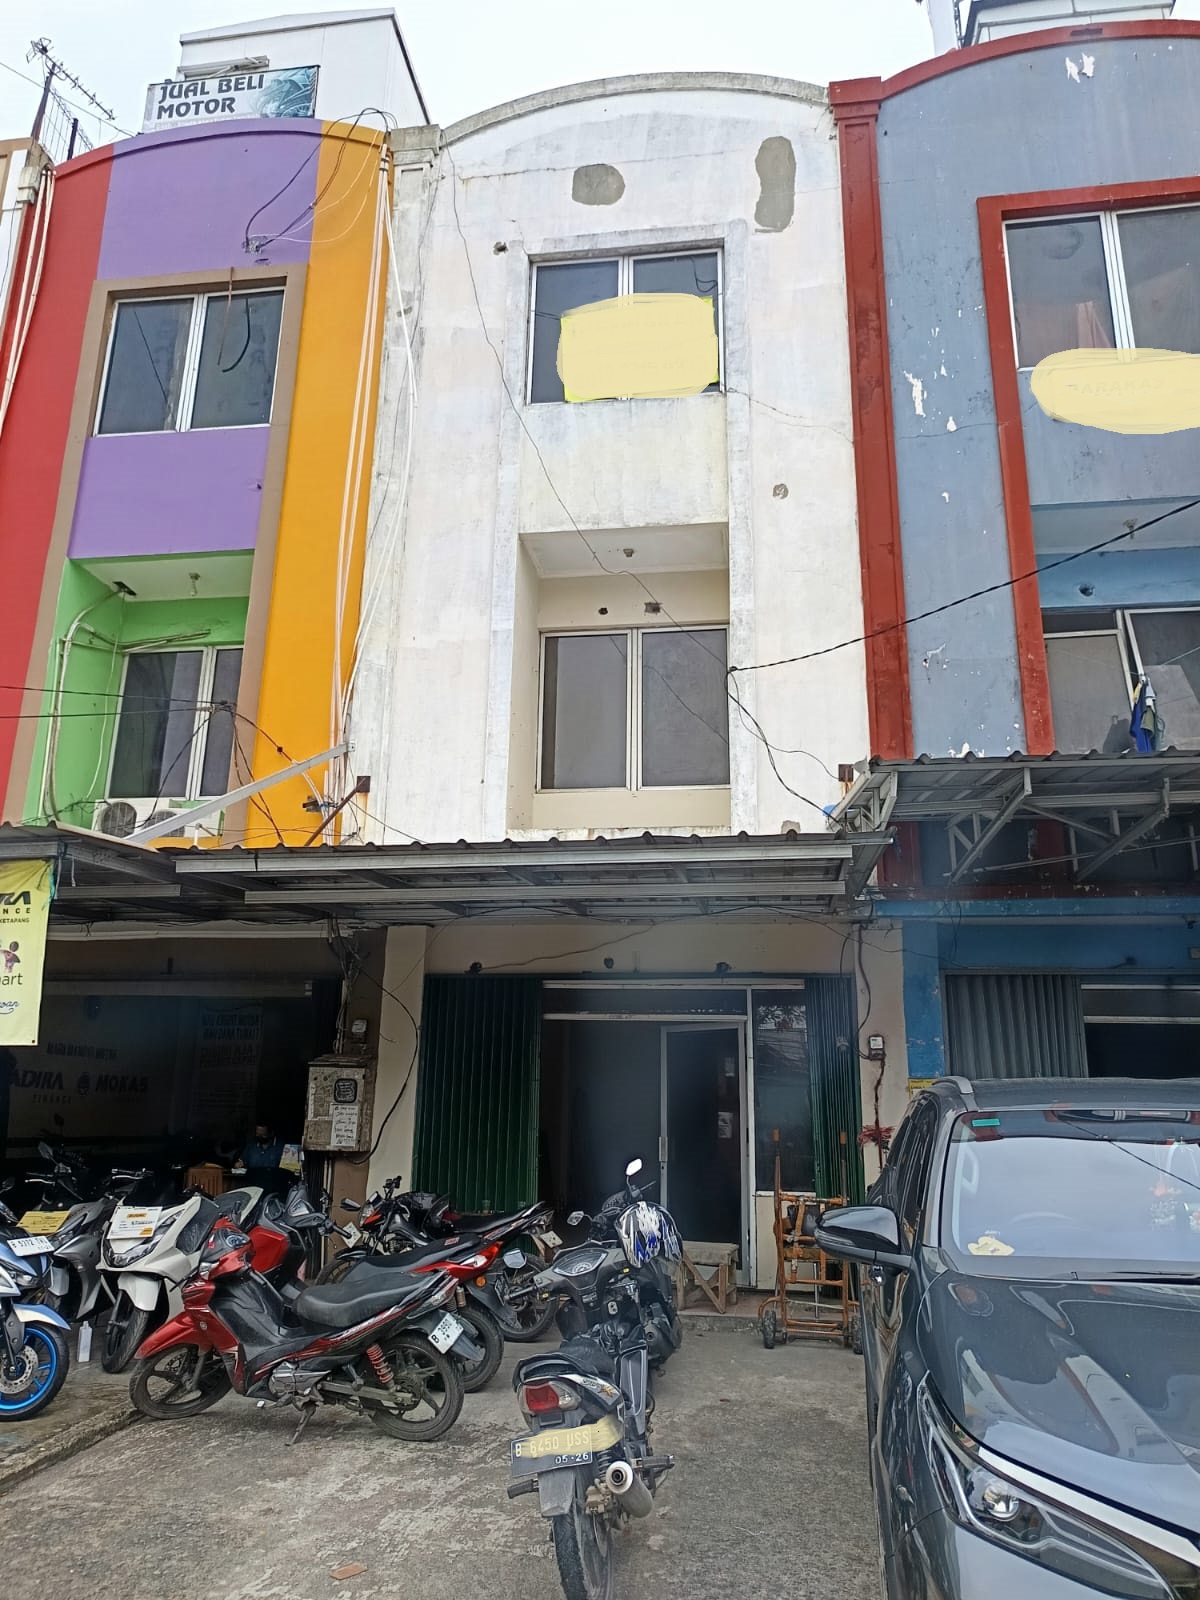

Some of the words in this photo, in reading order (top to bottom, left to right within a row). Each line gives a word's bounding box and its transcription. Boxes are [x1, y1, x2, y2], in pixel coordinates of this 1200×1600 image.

[158, 82, 210, 104] JUAL
[218, 75, 265, 94] BELI
[157, 97, 236, 120] MOTOR
[0, 972, 24, 986] art
[431, 1334, 440, 1343] B
[515, 1443, 522, 1457] B
